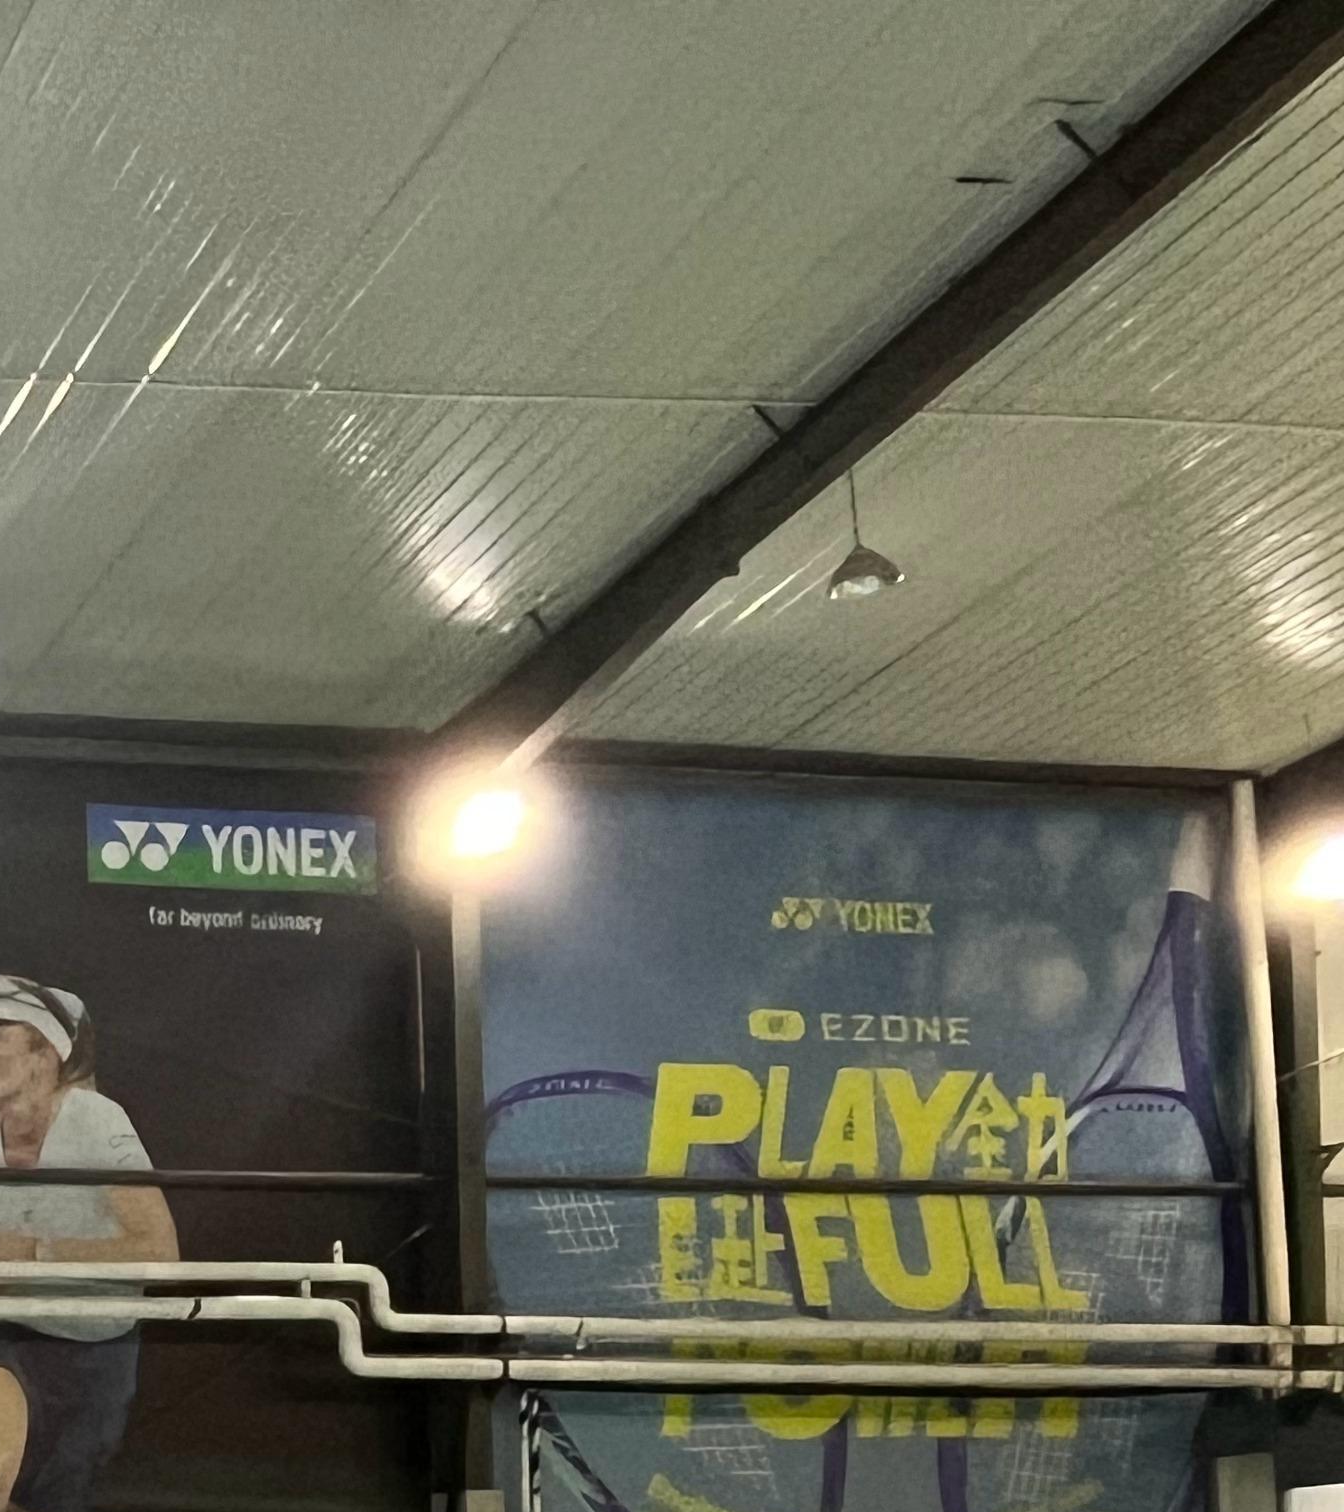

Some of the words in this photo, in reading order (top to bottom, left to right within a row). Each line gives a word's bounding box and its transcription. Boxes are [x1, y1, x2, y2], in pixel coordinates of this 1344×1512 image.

[201, 823, 358, 879] YONEX
[149, 906, 175, 925] far
[180, 908, 244, 931] beyond
[836, 899, 934, 935] YONEX
[820, 1012, 972, 1047] EZONE
[646, 1062, 978, 1180] PLAY
[782, 1192, 1091, 1312] FULL
